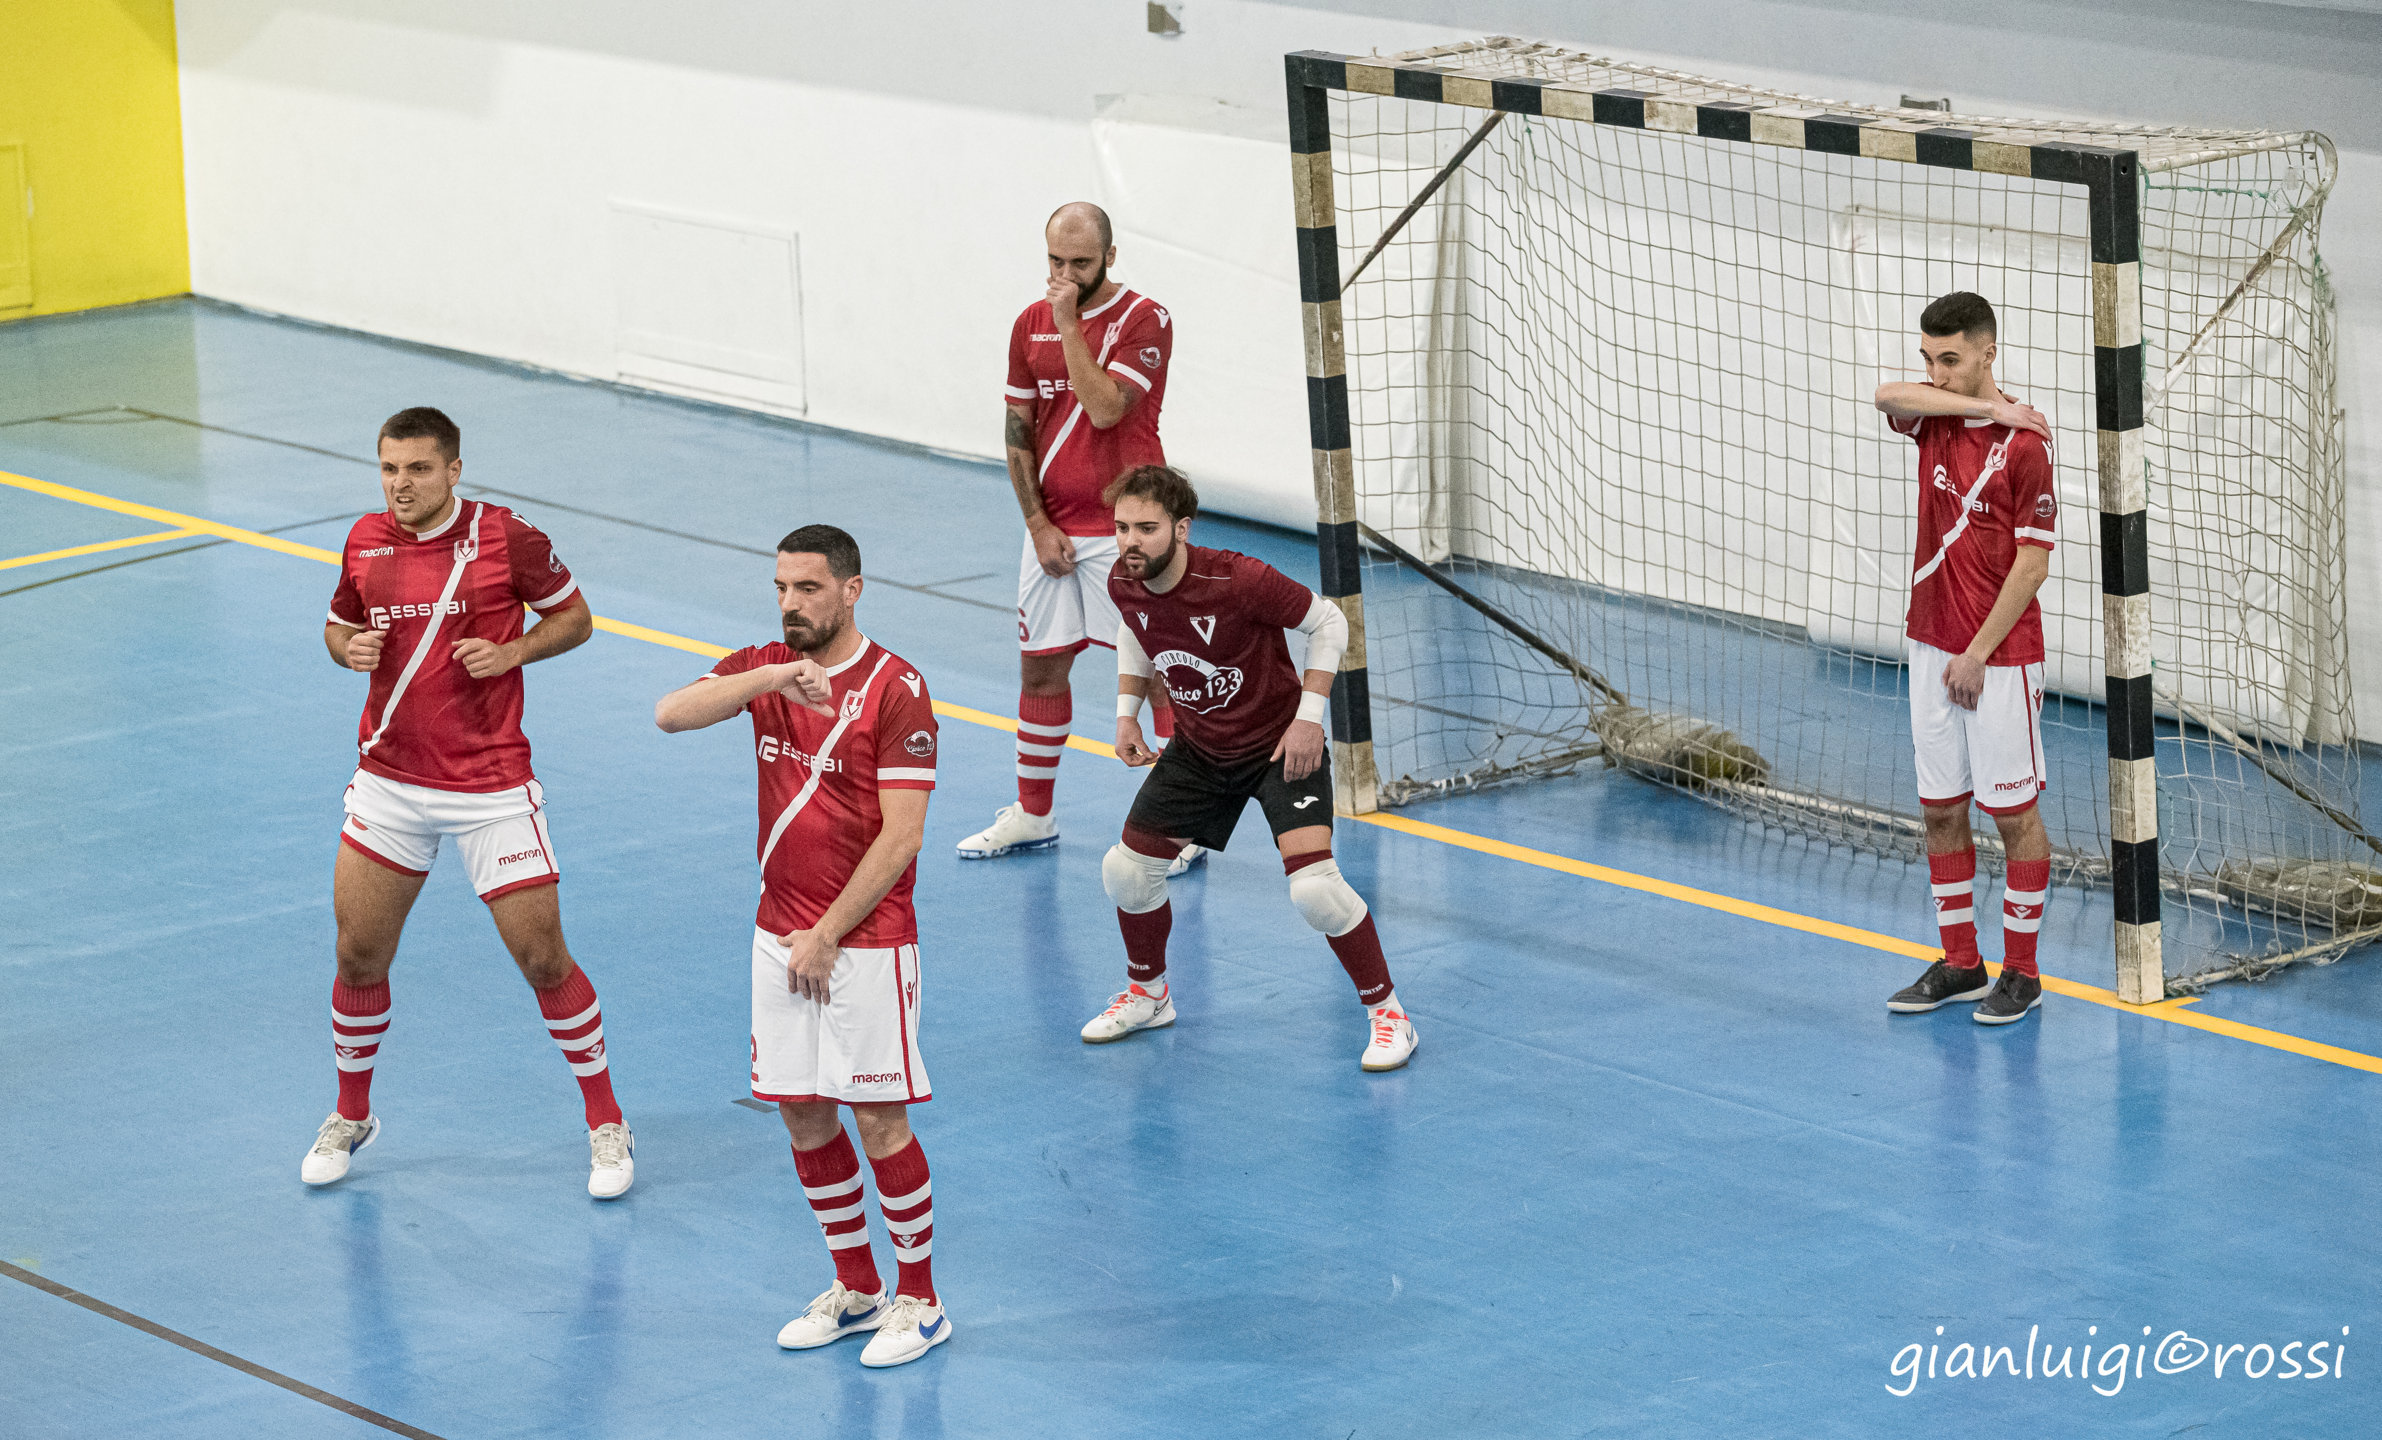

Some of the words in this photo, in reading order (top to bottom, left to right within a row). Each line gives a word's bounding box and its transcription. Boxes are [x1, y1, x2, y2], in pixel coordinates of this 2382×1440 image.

[358, 546, 394, 558] macron
[1160, 652, 1200, 669] CIRCOLO
[1205, 670, 1242, 698] 123
[1994, 775, 2034, 791] macron
[498, 848, 542, 866] macron
[852, 1072, 902, 1084] macron
